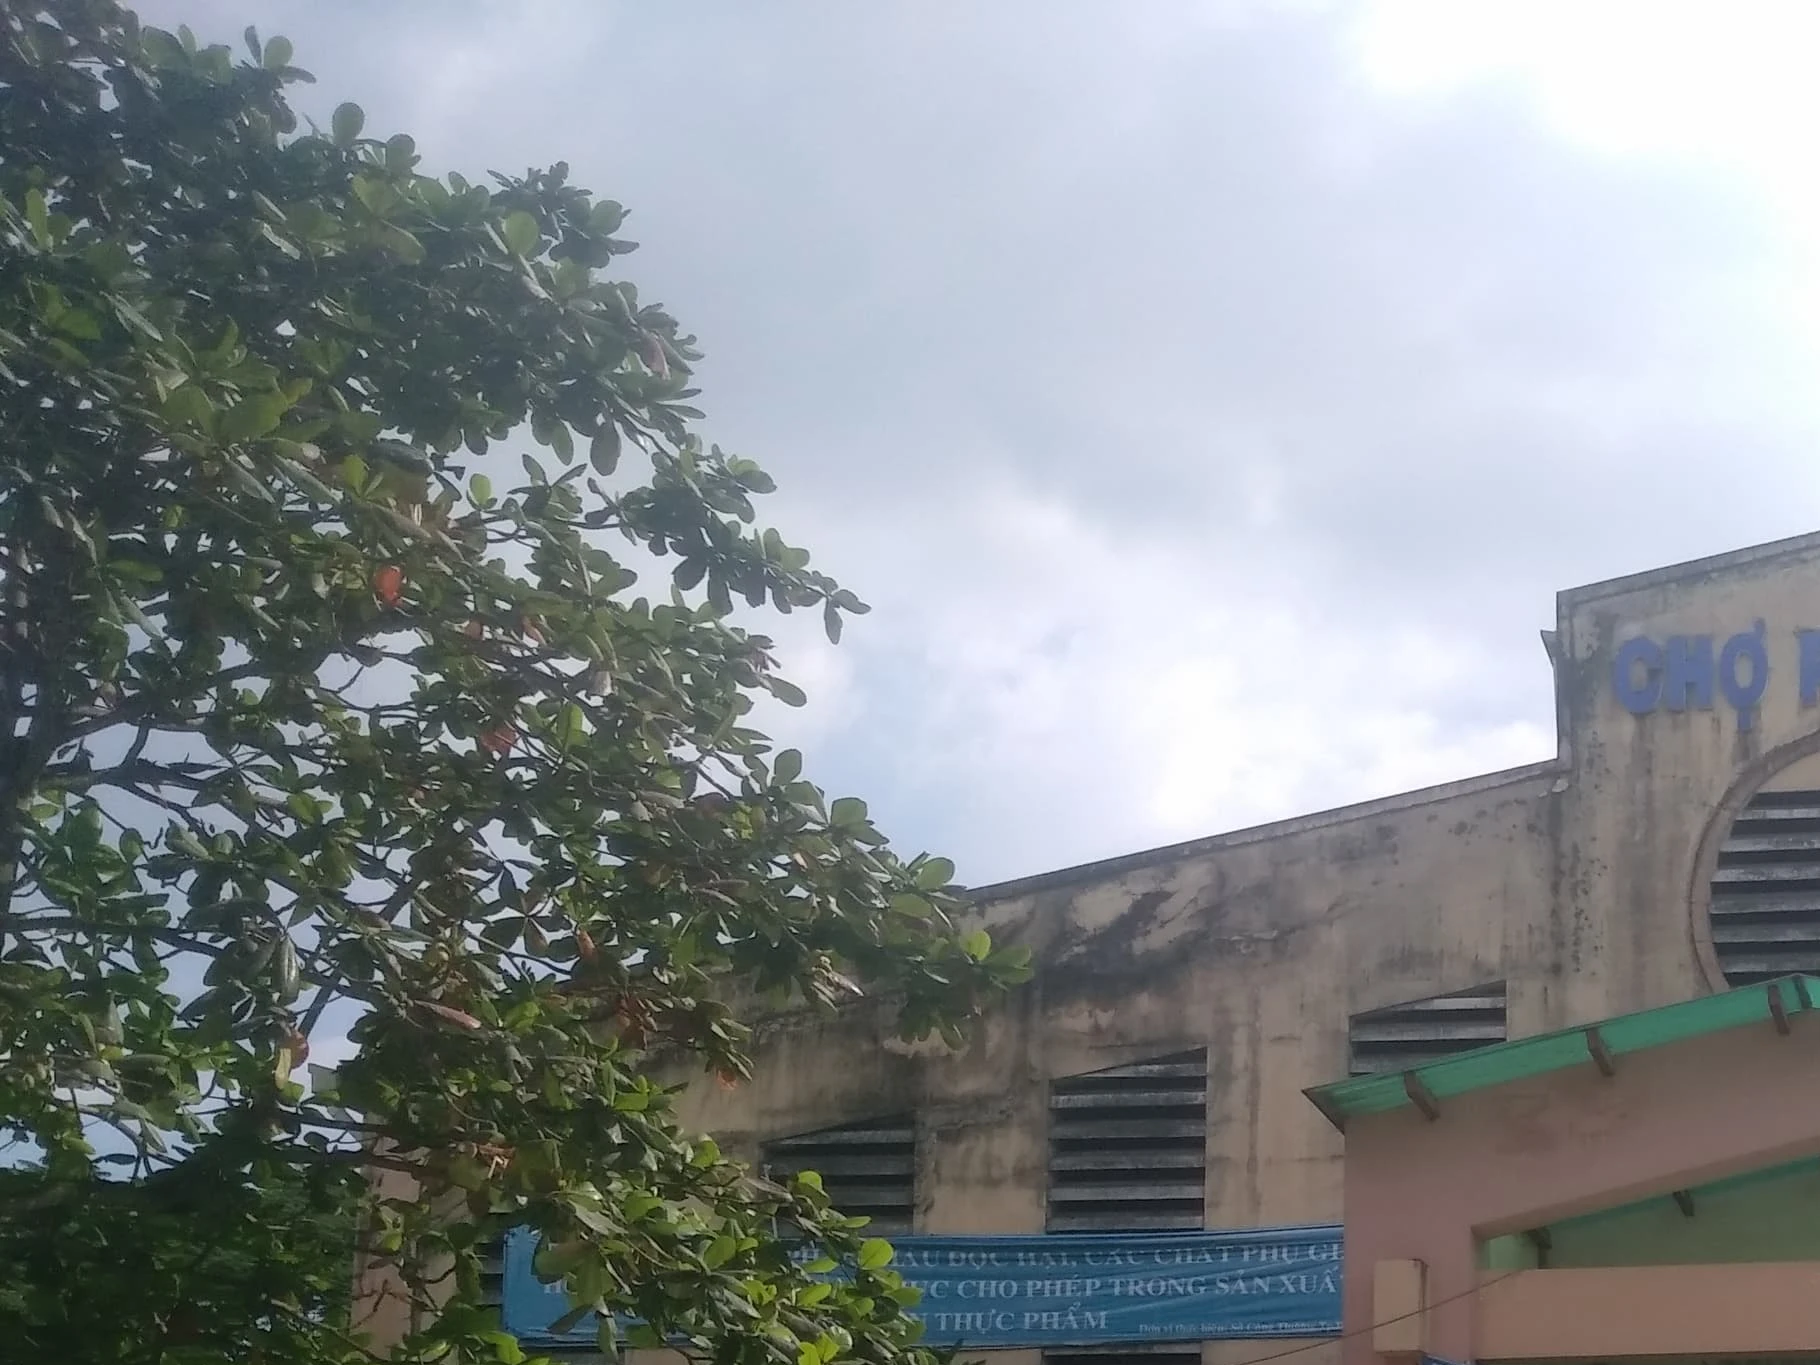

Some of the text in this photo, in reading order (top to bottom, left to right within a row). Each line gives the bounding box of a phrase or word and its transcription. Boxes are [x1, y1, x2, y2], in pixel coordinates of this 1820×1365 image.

[1613, 617, 1769, 731] CHỢ
[956, 1278, 1019, 1300] CHO
[1026, 1273, 1102, 1299] PHÉP
[1107, 1275, 1209, 1298] TRONG
[1279, 1264, 1345, 1296] XUẤ
[934, 1308, 1016, 1336] THỰC
[1022, 1301, 1109, 1332] PHẨM
